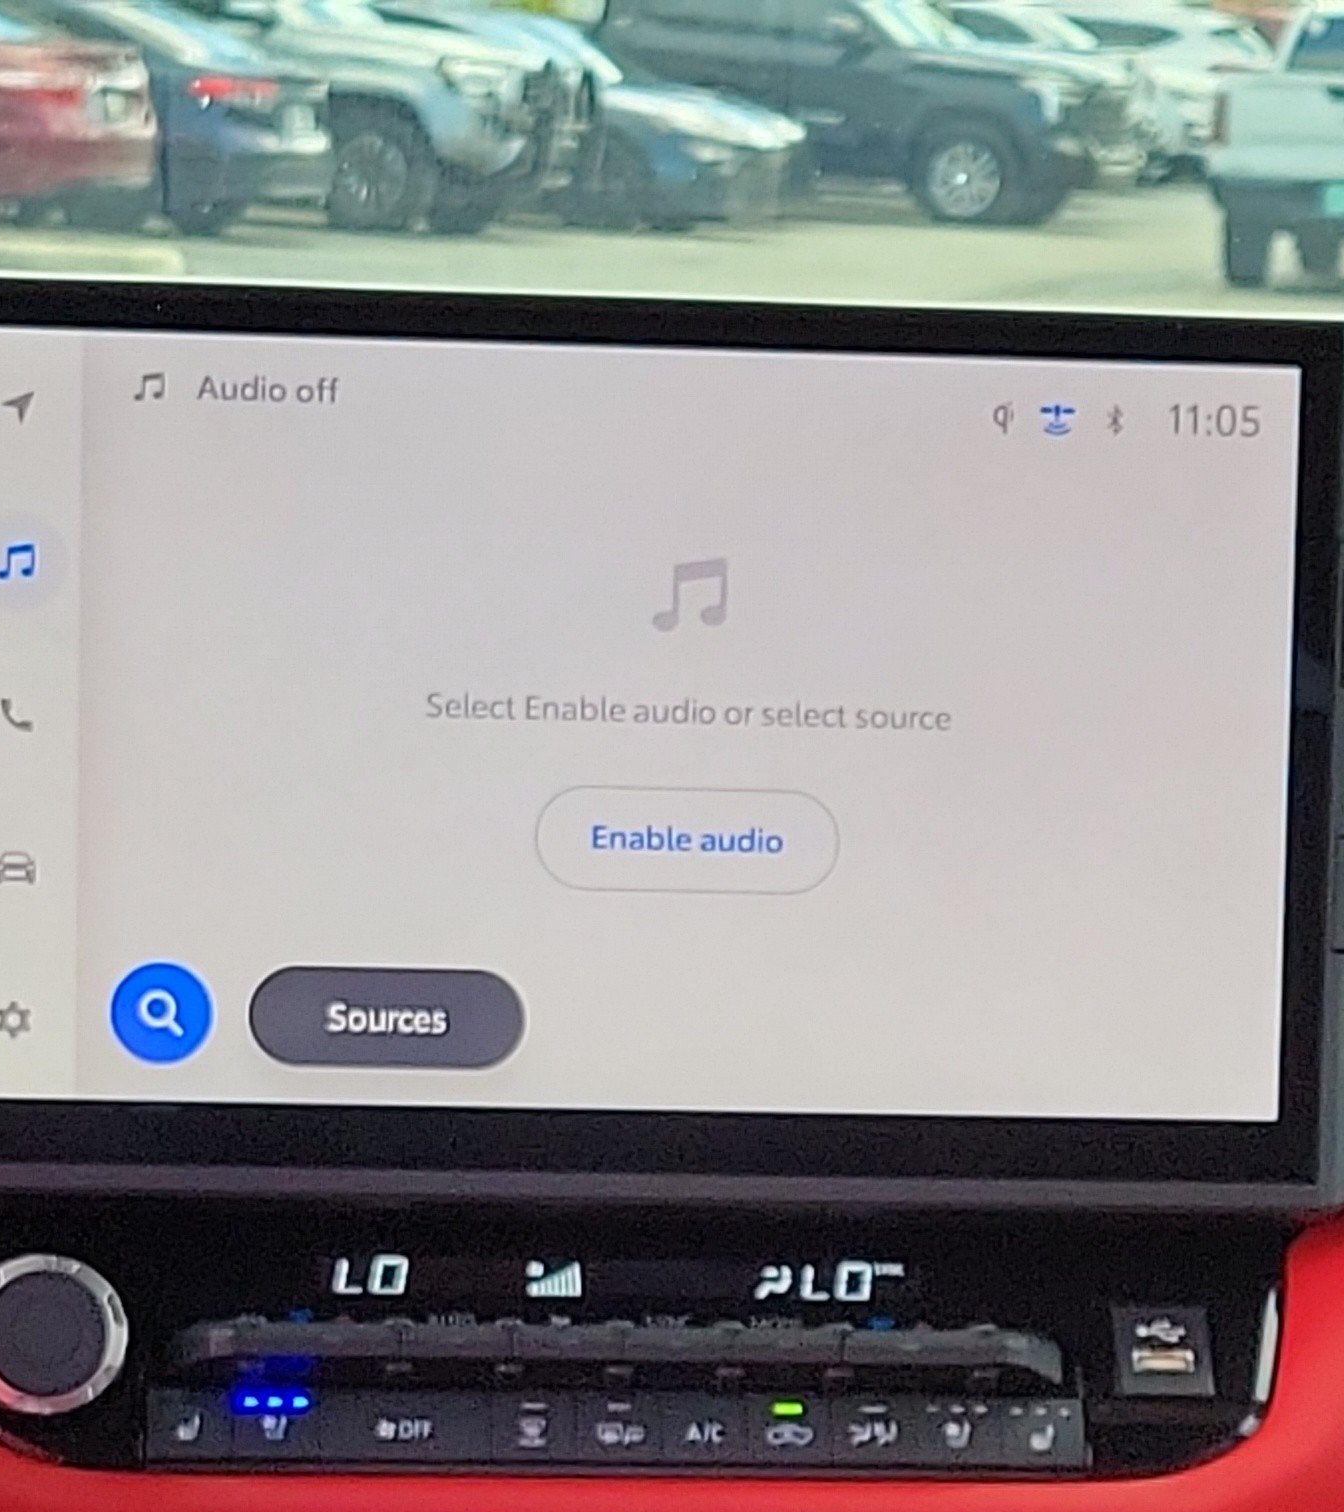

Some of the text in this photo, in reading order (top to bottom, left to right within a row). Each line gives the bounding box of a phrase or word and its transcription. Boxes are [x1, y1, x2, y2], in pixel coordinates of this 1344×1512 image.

[196, 374, 339, 404] Audio off
[1168, 403, 1262, 438] 11:05
[425, 692, 953, 732] Select Enable audio or select source
[590, 824, 785, 855] Enable audio
[324, 1000, 451, 1037] Sources
[331, 1253, 410, 1296] LO
[684, 1420, 725, 1444] A/C
